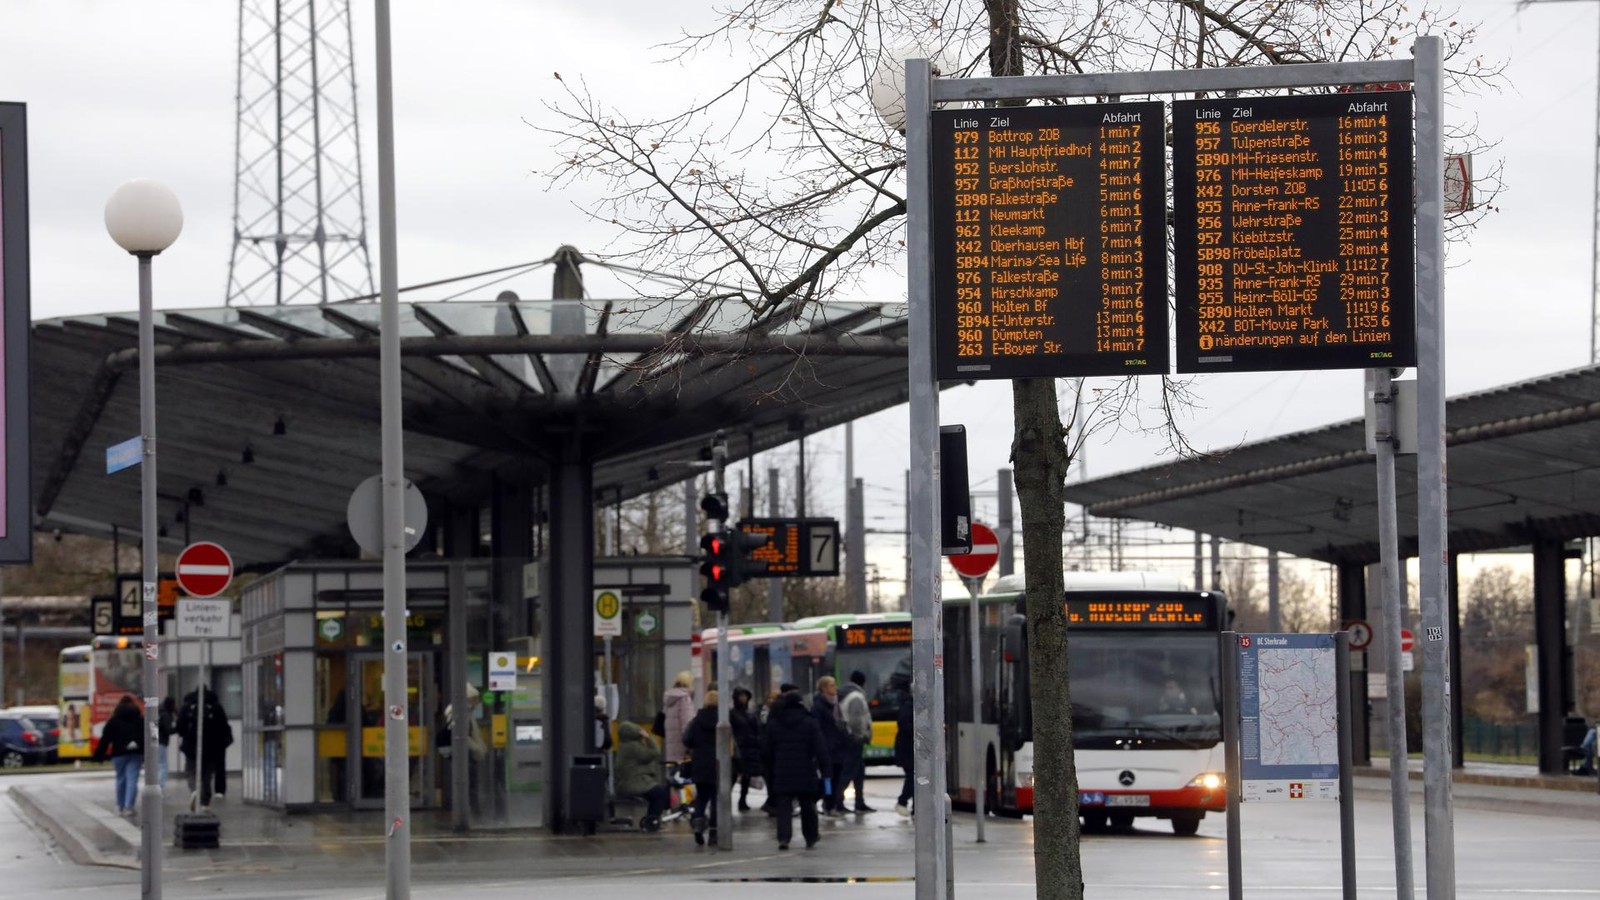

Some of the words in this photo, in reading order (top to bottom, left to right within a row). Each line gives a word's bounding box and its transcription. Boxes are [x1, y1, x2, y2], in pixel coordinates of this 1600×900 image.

[1196, 109, 1221, 119] Linie
[1232, 108, 1253, 118] Ziel
[1348, 102, 1388, 113] Abfahrt
[954, 118, 979, 129] Linie
[990, 117, 1009, 128] Ziel
[1102, 113, 1141, 123] Abfahrt
[1195, 122, 1220, 134] 956
[1231, 119, 1309, 133] Goerdelerstr.
[1338, 117, 1352, 129] 16
[1354, 118, 1376, 129] min
[1378, 116, 1387, 128] 4
[954, 131, 979, 144] 979
[989, 130, 1033, 143] Bottrop
[1038, 128, 1060, 141] ZOB
[1100, 127, 1105, 139] 1
[1109, 127, 1131, 138] min
[1132, 125, 1141, 137] 7
[1195, 137, 1221, 150] 957
[1232, 134, 1310, 150] Tulpenstraße
[954, 147, 979, 159] 112
[989, 146, 1006, 158] MH
[1011, 143, 1092, 159] Hauptfriedhof
[1196, 153, 1229, 166] SB90
[1232, 150, 1319, 164] MH-Friesenstr.
[1339, 148, 1352, 161] 16
[1355, 149, 1377, 160] min
[1379, 147, 1388, 159] 4
[954, 162, 980, 175] 952
[989, 160, 1059, 174] Everslohstr.
[1100, 158, 1107, 170] 4
[1109, 159, 1131, 170] min
[1132, 157, 1141, 169] 7
[1196, 169, 1222, 181] 976
[1339, 164, 1353, 176] 19
[1355, 165, 1377, 176] min
[1379, 163, 1388, 175] 5
[955, 178, 980, 191] 957
[989, 175, 1074, 191] Graßhofstraße
[1197, 185, 1223, 197] X42
[1232, 183, 1279, 196] Dorsten
[1284, 182, 1307, 194] ZOB
[1344, 179, 1376, 192] 11:05
[1379, 179, 1388, 191] 6
[955, 194, 988, 206] SB98
[989, 191, 1058, 206] Falkestraße
[1100, 190, 1107, 201] 5
[1109, 190, 1131, 201] min
[1133, 188, 1142, 200] 6
[1197, 200, 1222, 213] 955
[1232, 197, 1320, 212] Anne-Frank-RS
[955, 210, 980, 222] 112
[990, 207, 1045, 221] Neumarkt
[1197, 216, 1223, 228] 956
[1232, 214, 1302, 228] Wehrstraße
[1338, 212, 1353, 224] 22
[1355, 212, 1378, 223] min
[1380, 211, 1389, 222] 3
[955, 225, 981, 238] 962
[990, 224, 1046, 237] Kleekamp
[1100, 221, 1108, 233] 6
[1110, 222, 1132, 233] min
[1133, 220, 1143, 232] 7
[1197, 232, 1223, 245] 957
[1232, 230, 1295, 243] Kiebitzstr.
[1339, 228, 1354, 240] 25
[1356, 229, 1378, 240] min
[1380, 227, 1389, 239] 4
[956, 240, 982, 253] X42
[991, 239, 1060, 252] Oberhausen
[1065, 237, 1085, 251] Hbf
[1198, 248, 1231, 260] SB98
[1233, 246, 1301, 260] Fröbelplatz
[957, 256, 989, 268] SB94
[991, 254, 1060, 267] Marina/Sea
[1065, 253, 1087, 267] Life
[1102, 252, 1109, 264] 8
[1111, 253, 1132, 264] min
[1134, 251, 1143, 263] 3
[1198, 264, 1223, 276] 908
[1345, 259, 1378, 271] 11:12
[1381, 259, 1389, 270] 7
[957, 272, 982, 284] 976
[991, 269, 1059, 284] Falkestraße
[1198, 278, 1224, 290] 935
[1234, 275, 1321, 289] Anne-Frank-RS
[1340, 274, 1355, 286] 29
[1356, 275, 1379, 285] min
[1381, 273, 1389, 285] 7
[957, 287, 982, 300] 954
[992, 286, 1058, 299] Hirschkamp
[1102, 284, 1109, 296] 9
[1112, 285, 1133, 295] min
[1135, 283, 1144, 295] 7
[1199, 292, 1224, 304] 955
[1340, 288, 1355, 300] 29
[1356, 289, 1379, 299] min
[1381, 287, 1390, 299] 3
[957, 301, 982, 314] 960
[992, 300, 1030, 313] Holten
[1035, 300, 1048, 314] Bf
[1199, 306, 1232, 318] SB90
[1234, 305, 1273, 317] Holten
[1278, 303, 1313, 316] Markt
[1346, 302, 1378, 314] 11:19
[1381, 301, 1390, 313] 6
[958, 315, 990, 328] SB94
[992, 314, 1056, 327] E-Unterstr.
[1097, 312, 1110, 324] 13
[1112, 313, 1134, 323] min
[1135, 311, 1144, 323] 6
[1199, 320, 1225, 332] X42
[1234, 318, 1298, 331] BOT-Movie
[1304, 317, 1329, 329] Park
[1346, 316, 1378, 328] 11:35
[1382, 316, 1390, 327] 6
[958, 329, 983, 342] 960
[992, 328, 1043, 342] Dümpten
[1299, 332, 1319, 346] auf
[1326, 331, 1347, 343] den
[1353, 330, 1391, 342] Linien
[958, 343, 983, 355] 263
[992, 343, 1038, 356] E-Boyer
[1044, 341, 1063, 353] Str.
[1097, 340, 1110, 352] 14
[1113, 341, 1134, 351] min
[1136, 339, 1145, 351] 7
[812, 534, 831, 563] 7
[123, 587, 137, 610] 4
[186, 602, 221, 612] Linien-
[95, 607, 111, 627] 5
[184, 614, 223, 623] verkehr
[195, 625, 213, 634] frei
[1242, 638, 1250, 647] 15
